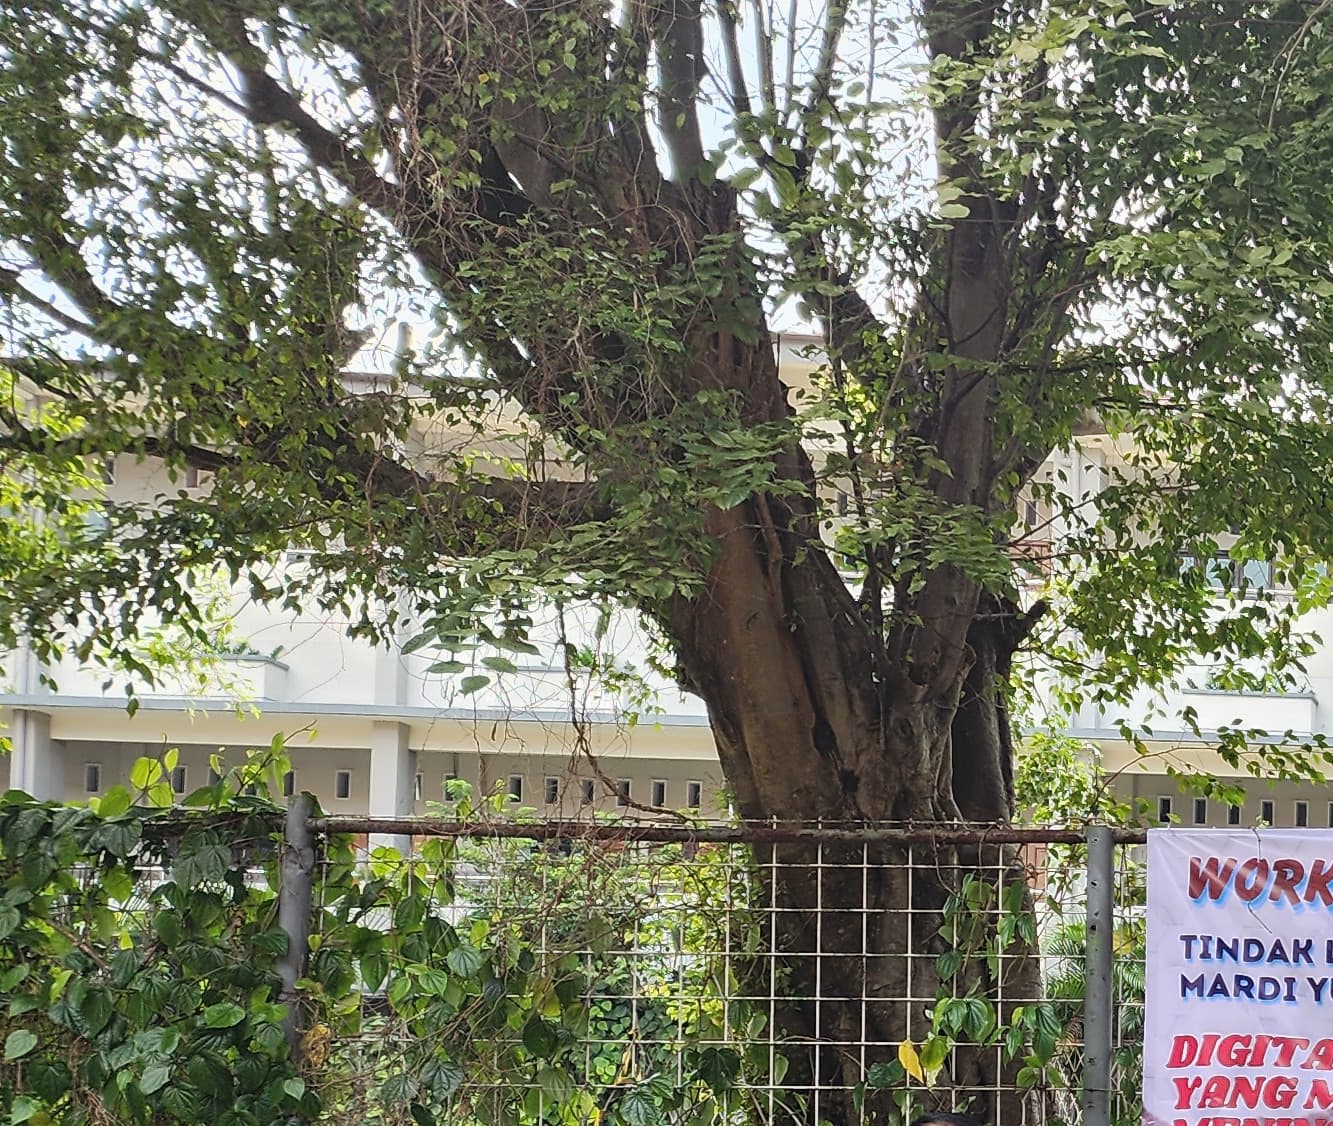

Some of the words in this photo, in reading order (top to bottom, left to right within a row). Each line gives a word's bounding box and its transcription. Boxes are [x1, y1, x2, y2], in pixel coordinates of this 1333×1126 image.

[1180, 934, 1314, 964] TINDAK
[1180, 973, 1296, 1001] MARDI
[1172, 1075, 1298, 1109] YANG
